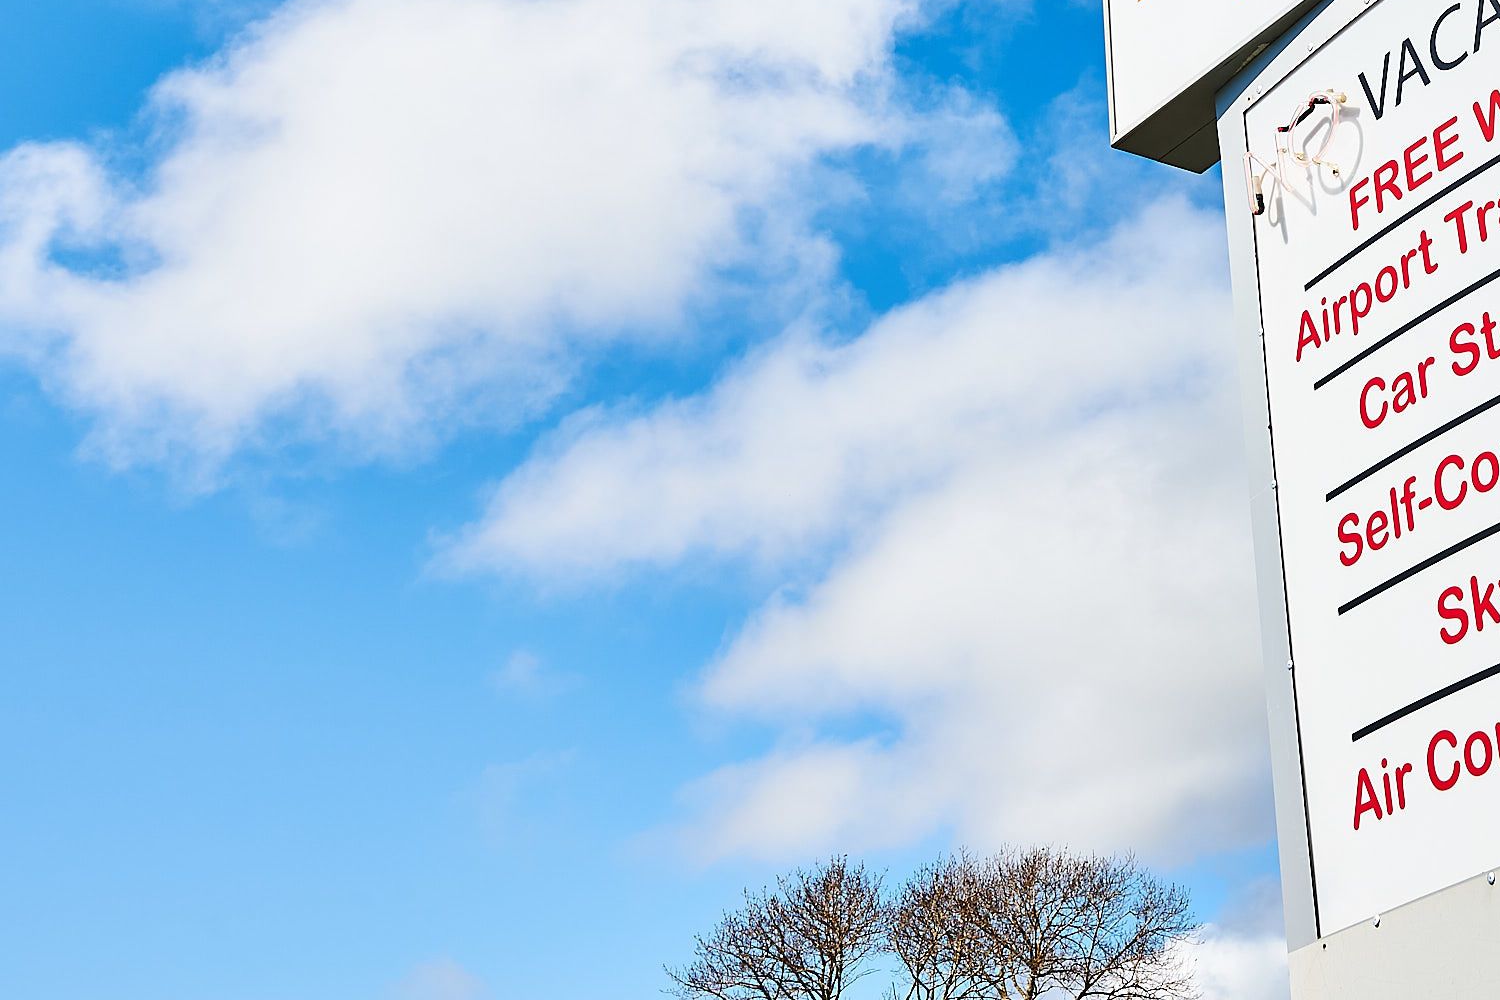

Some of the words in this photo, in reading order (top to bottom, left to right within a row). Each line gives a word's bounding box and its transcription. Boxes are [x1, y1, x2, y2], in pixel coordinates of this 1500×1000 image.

[1349, 116, 1464, 230] FREE
[1295, 231, 1438, 361] Airport
[1359, 357, 1436, 429] Car
[1353, 757, 1412, 830] Air
